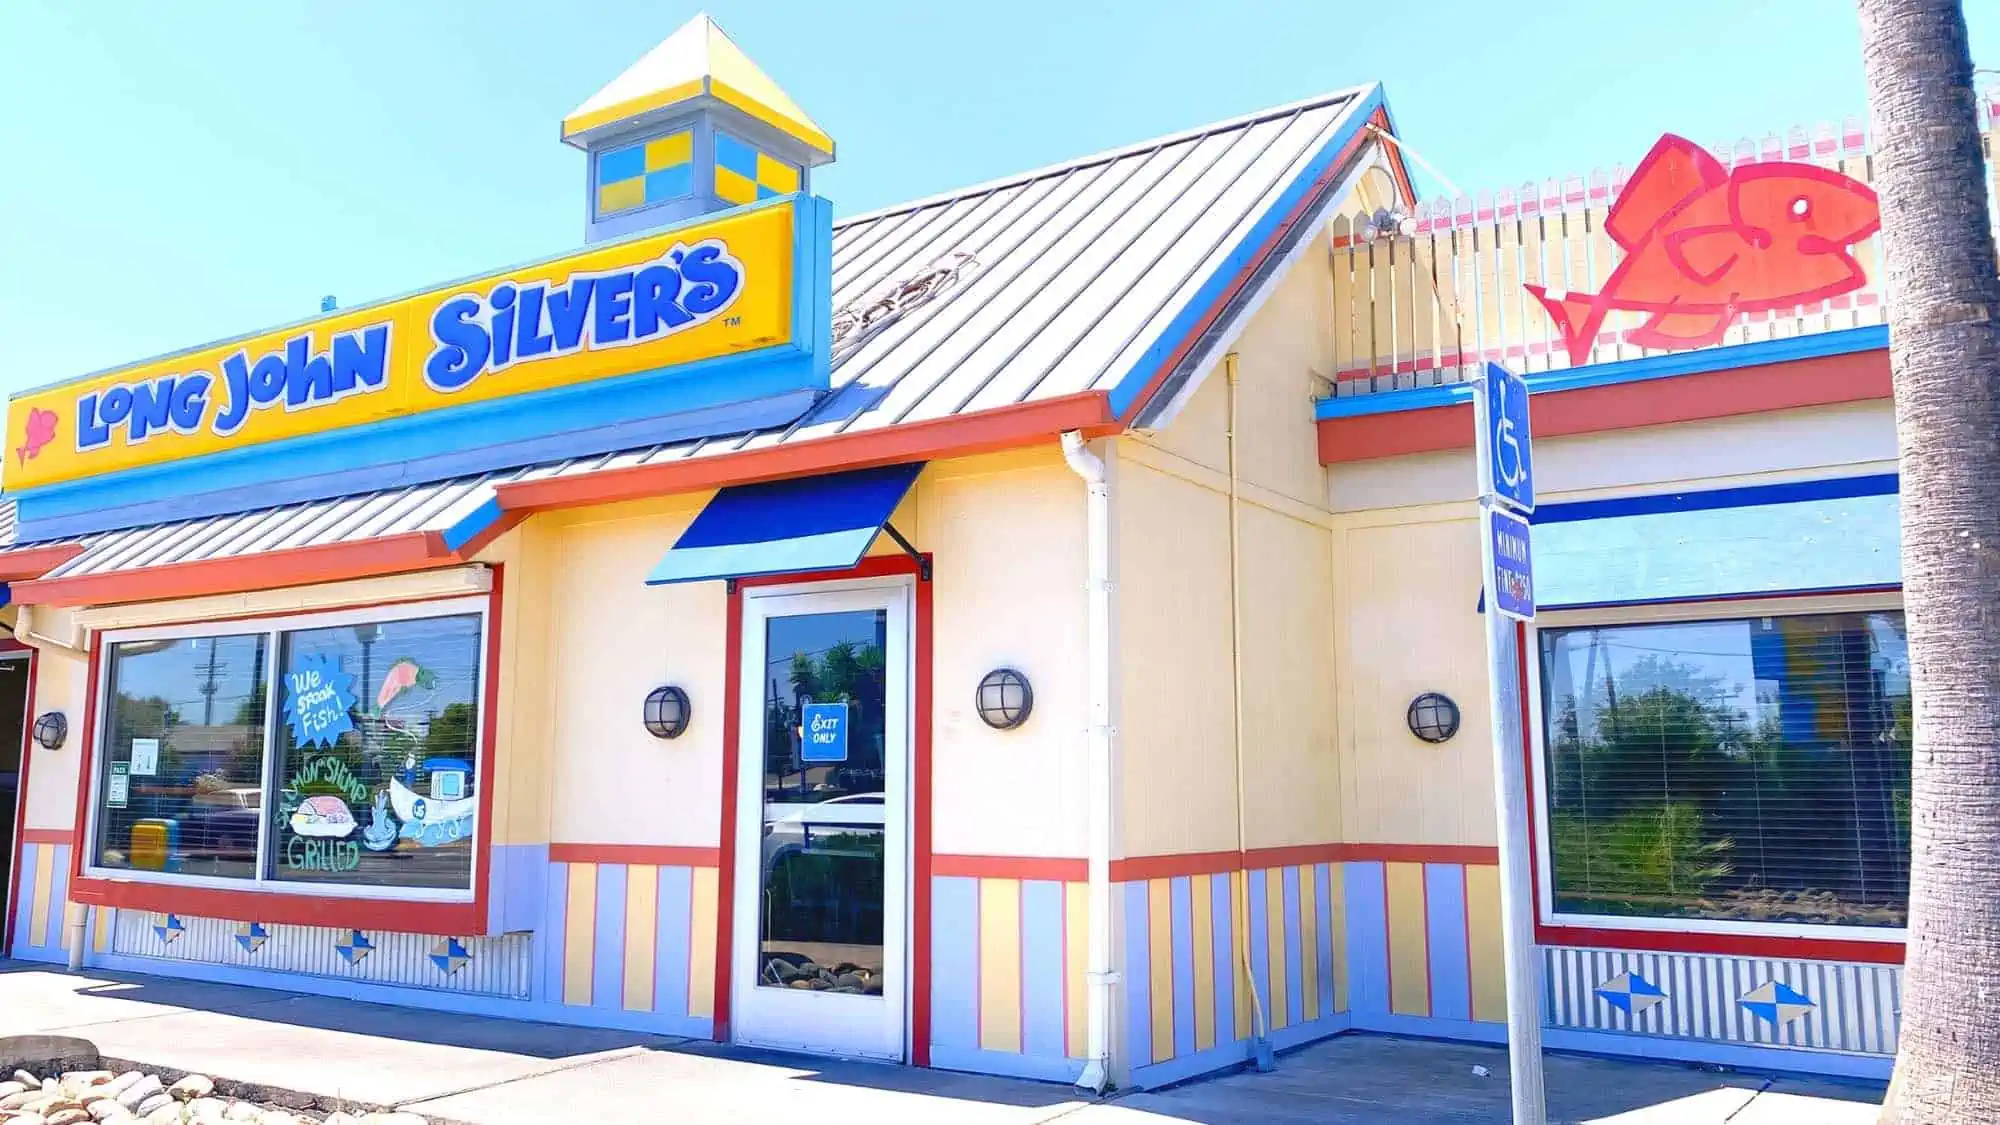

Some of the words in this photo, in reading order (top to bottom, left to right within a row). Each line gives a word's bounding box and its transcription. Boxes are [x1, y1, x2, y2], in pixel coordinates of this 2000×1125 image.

[77, 373, 213, 450] LONG
[212, 325, 391, 434] JOHN
[424, 242, 742, 391] SILVER'S
[1496, 529, 1529, 565] MINIMUM
[292, 670, 320, 693] We
[811, 713, 839, 732] EXIT
[813, 732, 837, 744] ONLY
